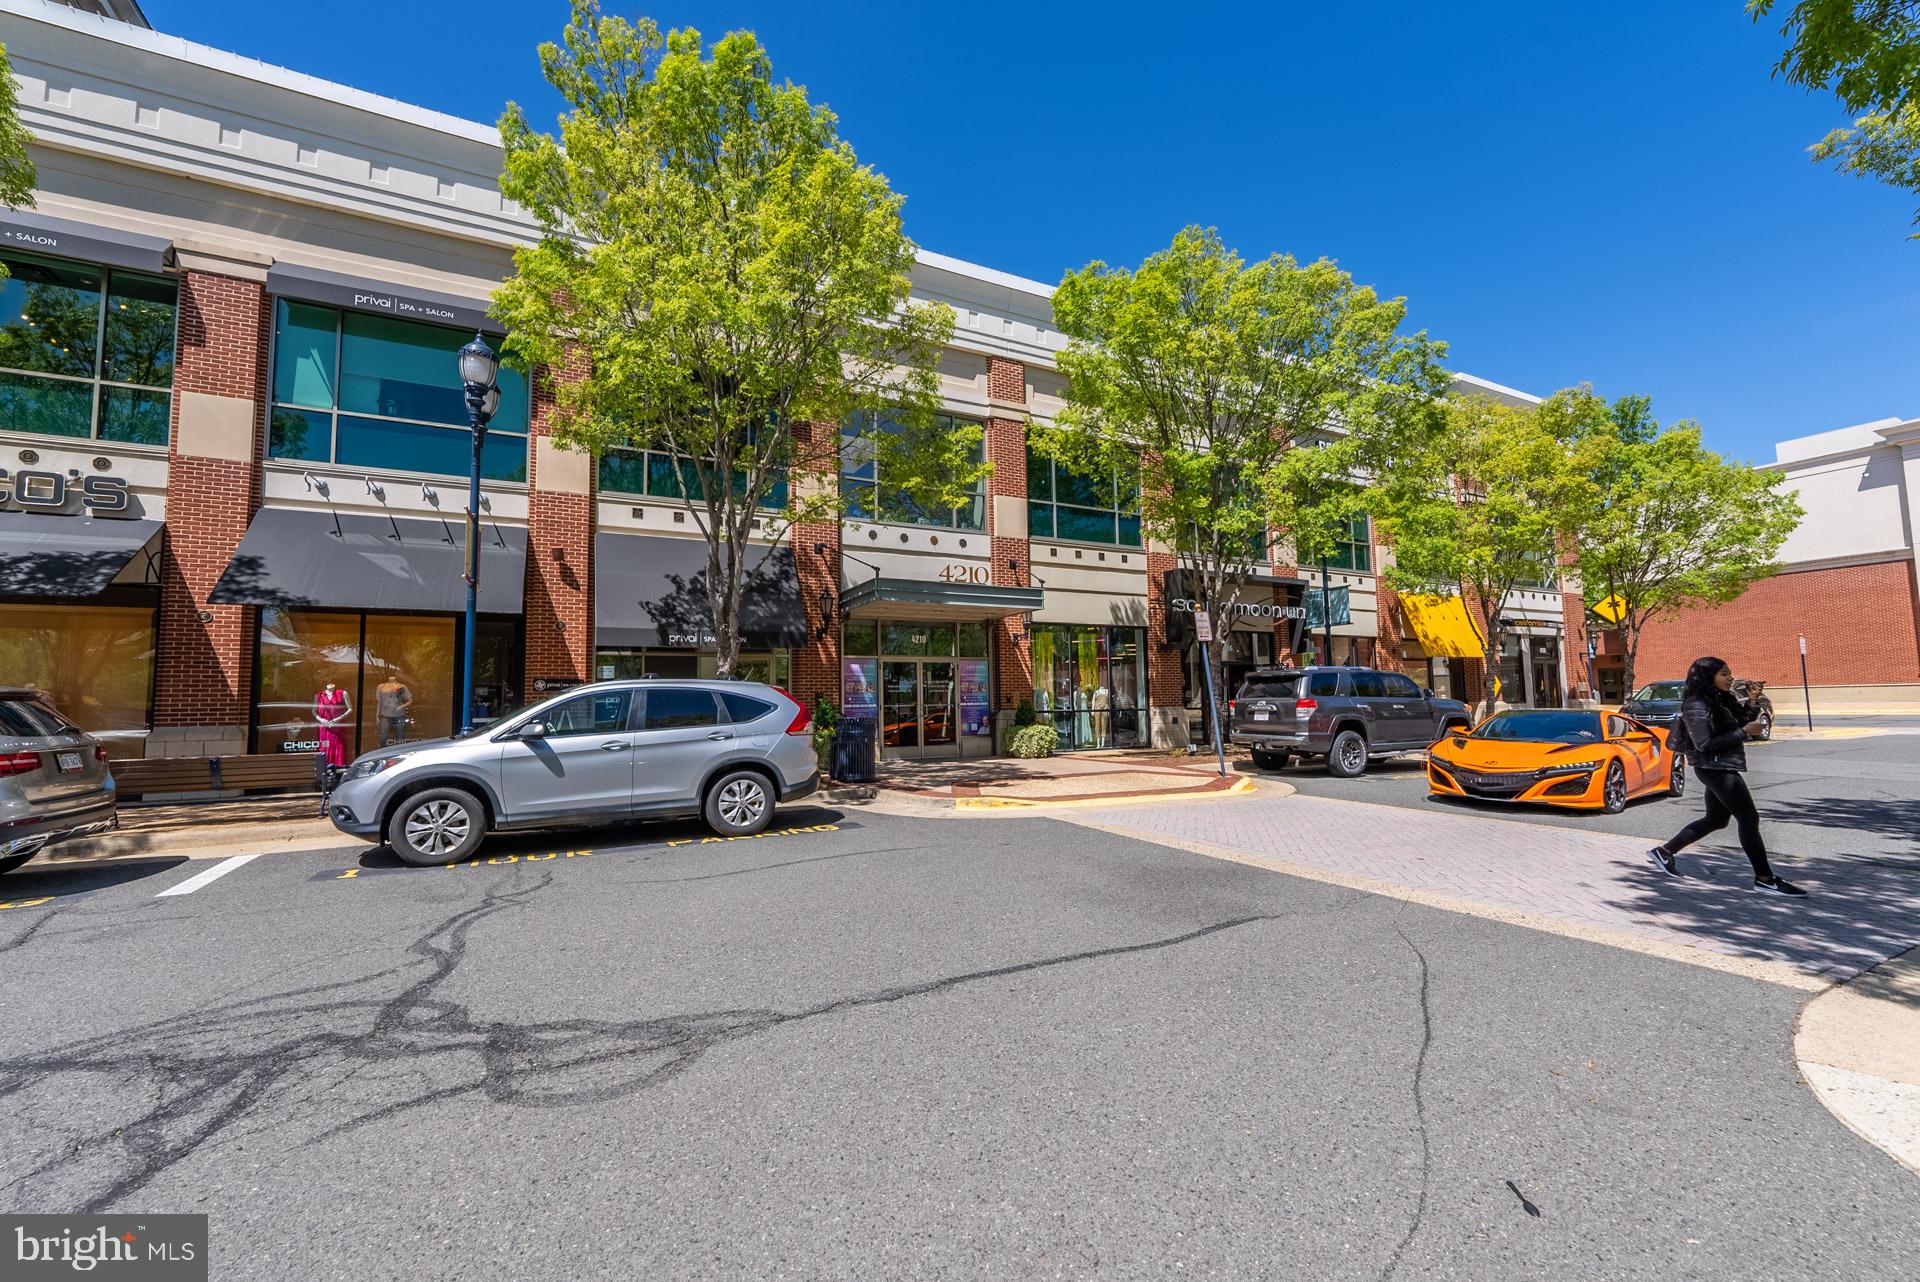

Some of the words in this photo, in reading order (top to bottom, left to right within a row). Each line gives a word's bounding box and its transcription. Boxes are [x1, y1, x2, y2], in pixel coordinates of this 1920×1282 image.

[16, 232, 57, 247] SALON
[354, 294, 391, 308] privai
[400, 303, 416, 312] SPA
[425, 308, 454, 319] SALON
[0, 468, 128, 510] O'S
[938, 563, 990, 585] 4210
[1233, 602, 1282, 618] moon
[668, 633, 698, 646] privai
[911, 634, 927, 644] 4210
[283, 740, 331, 749] CHICO'S
